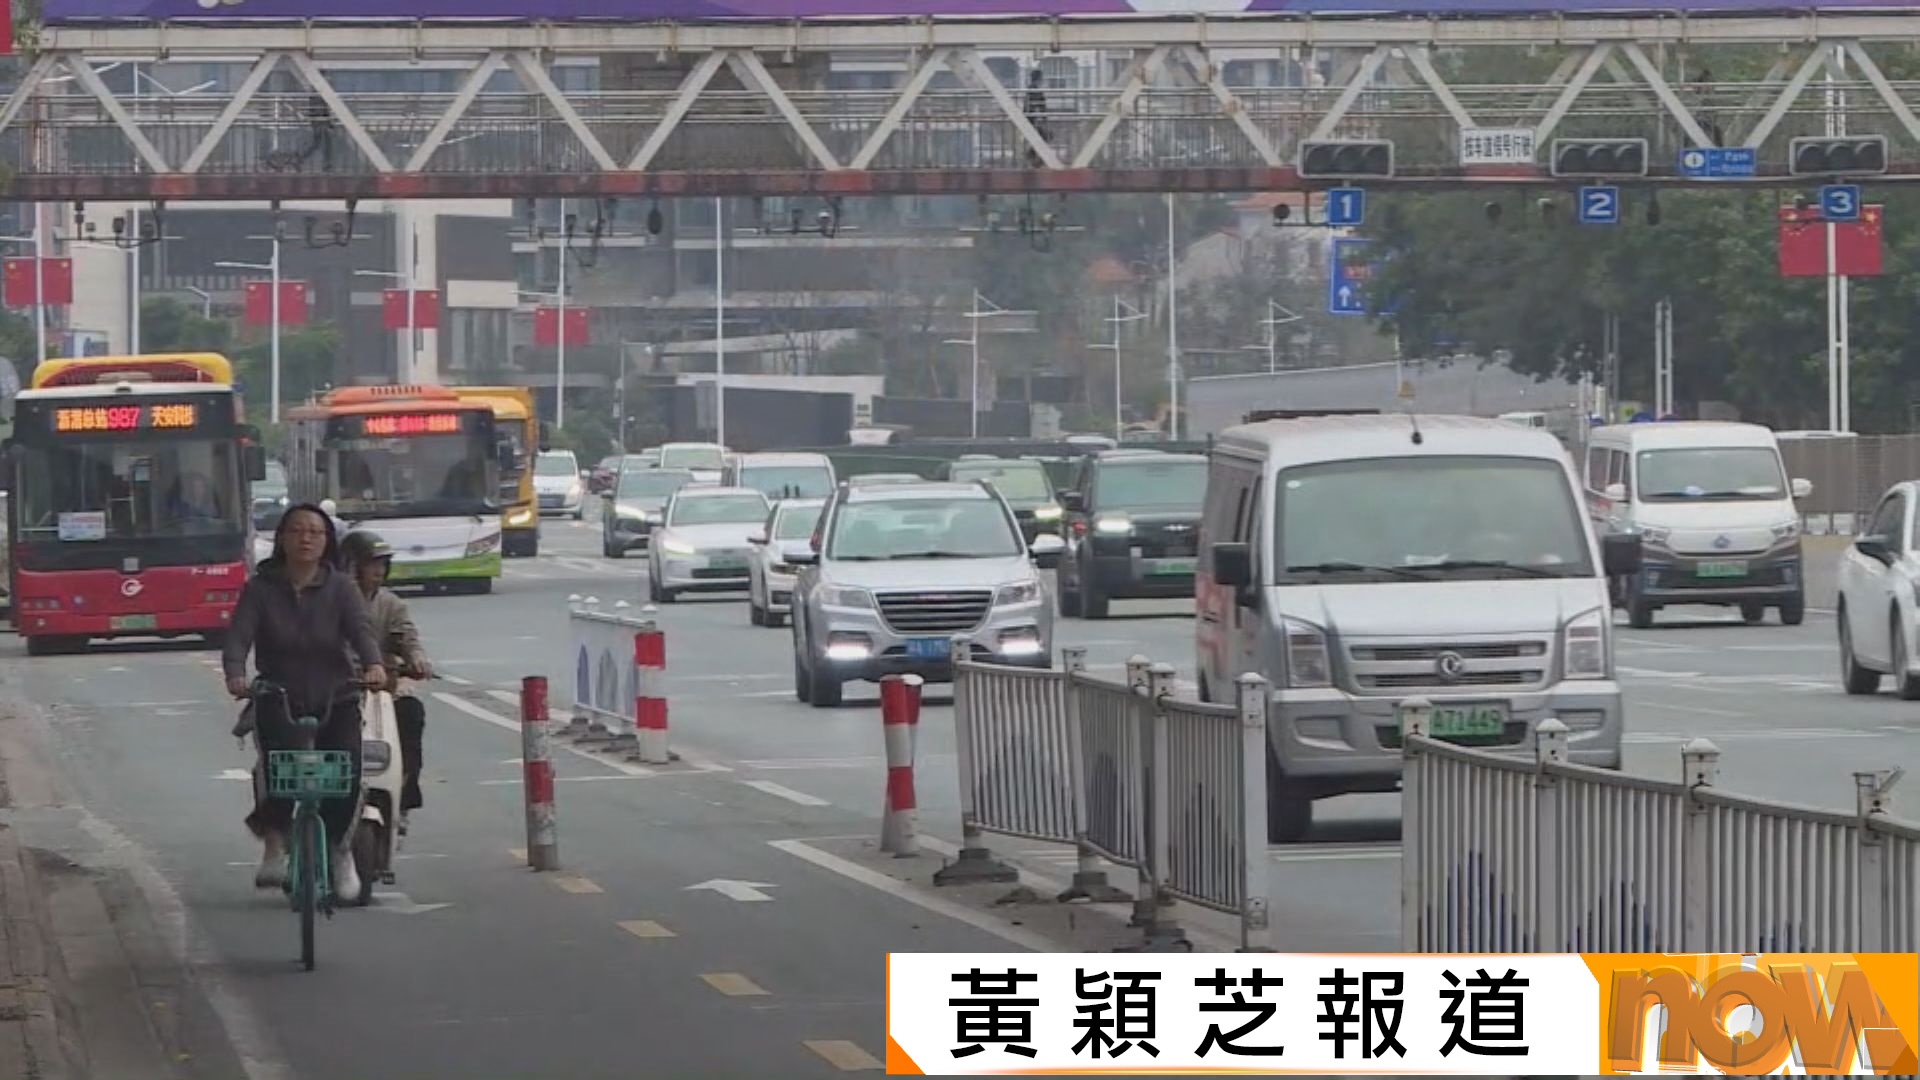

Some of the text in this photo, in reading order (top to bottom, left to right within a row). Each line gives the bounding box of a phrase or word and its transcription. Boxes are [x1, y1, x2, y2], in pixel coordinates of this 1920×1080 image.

[1464, 133, 1533, 158] 按车道信号行驶
[1341, 193, 1352, 219] 1
[1587, 192, 1611, 216] 2
[1829, 190, 1852, 214] 3
[108, 406, 141, 429] 987
